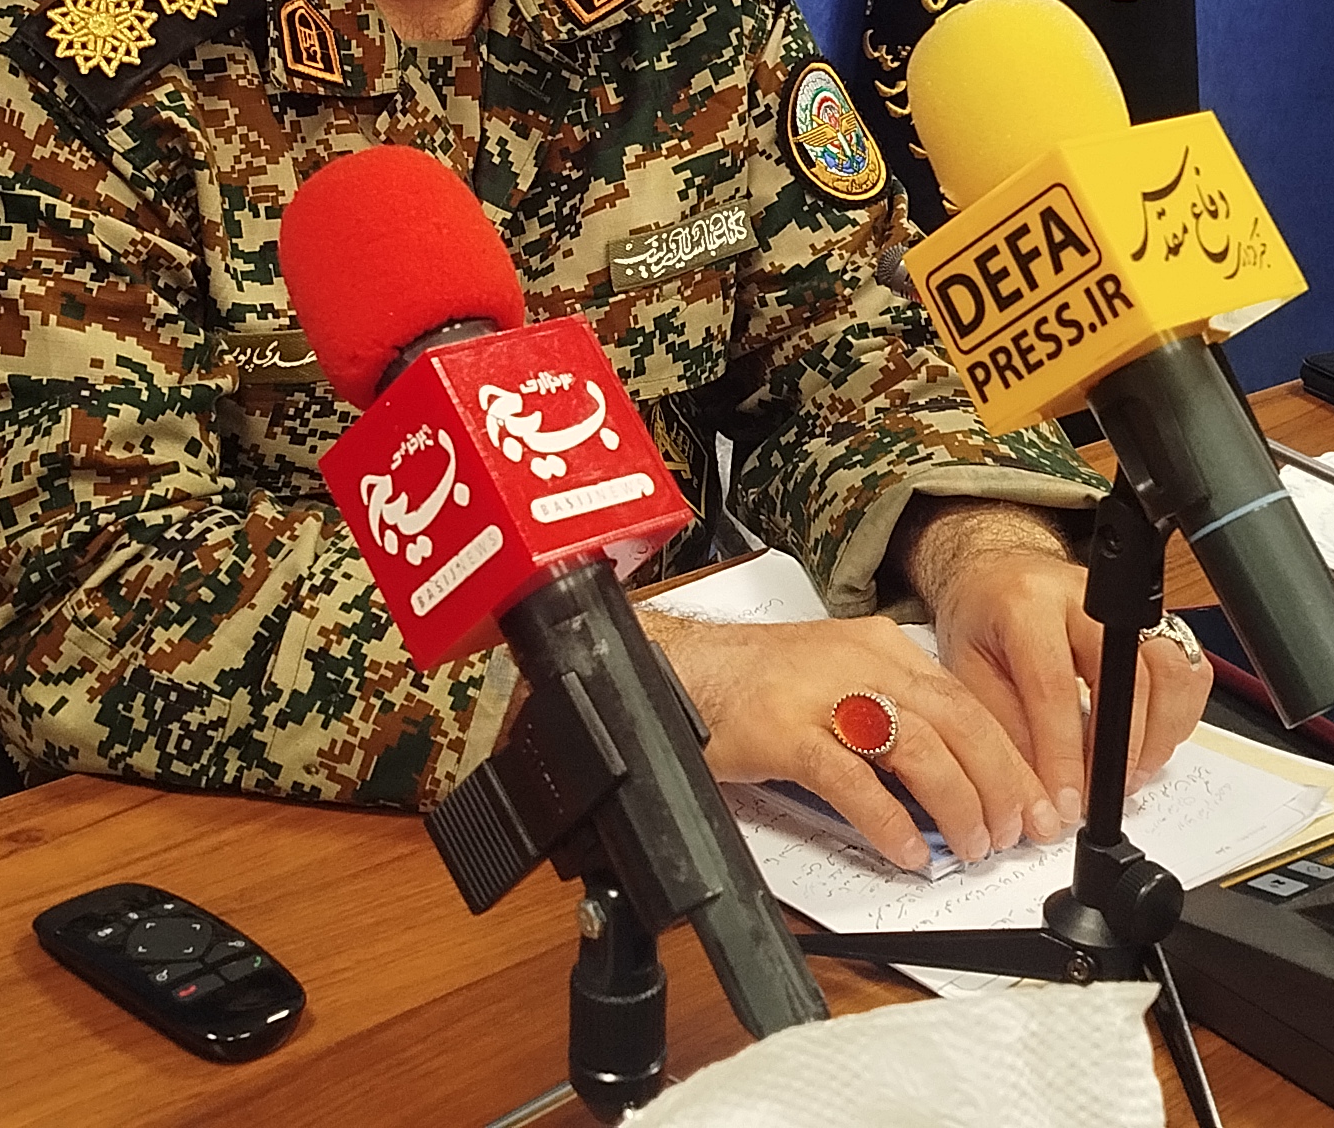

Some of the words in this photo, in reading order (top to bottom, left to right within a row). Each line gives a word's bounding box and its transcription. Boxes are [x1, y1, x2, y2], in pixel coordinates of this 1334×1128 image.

[933, 204, 1091, 342] DEFA
[965, 271, 1135, 404] PRESS.IR
[359, 428, 471, 566] بسیج
[478, 379, 620, 480] بسیج
